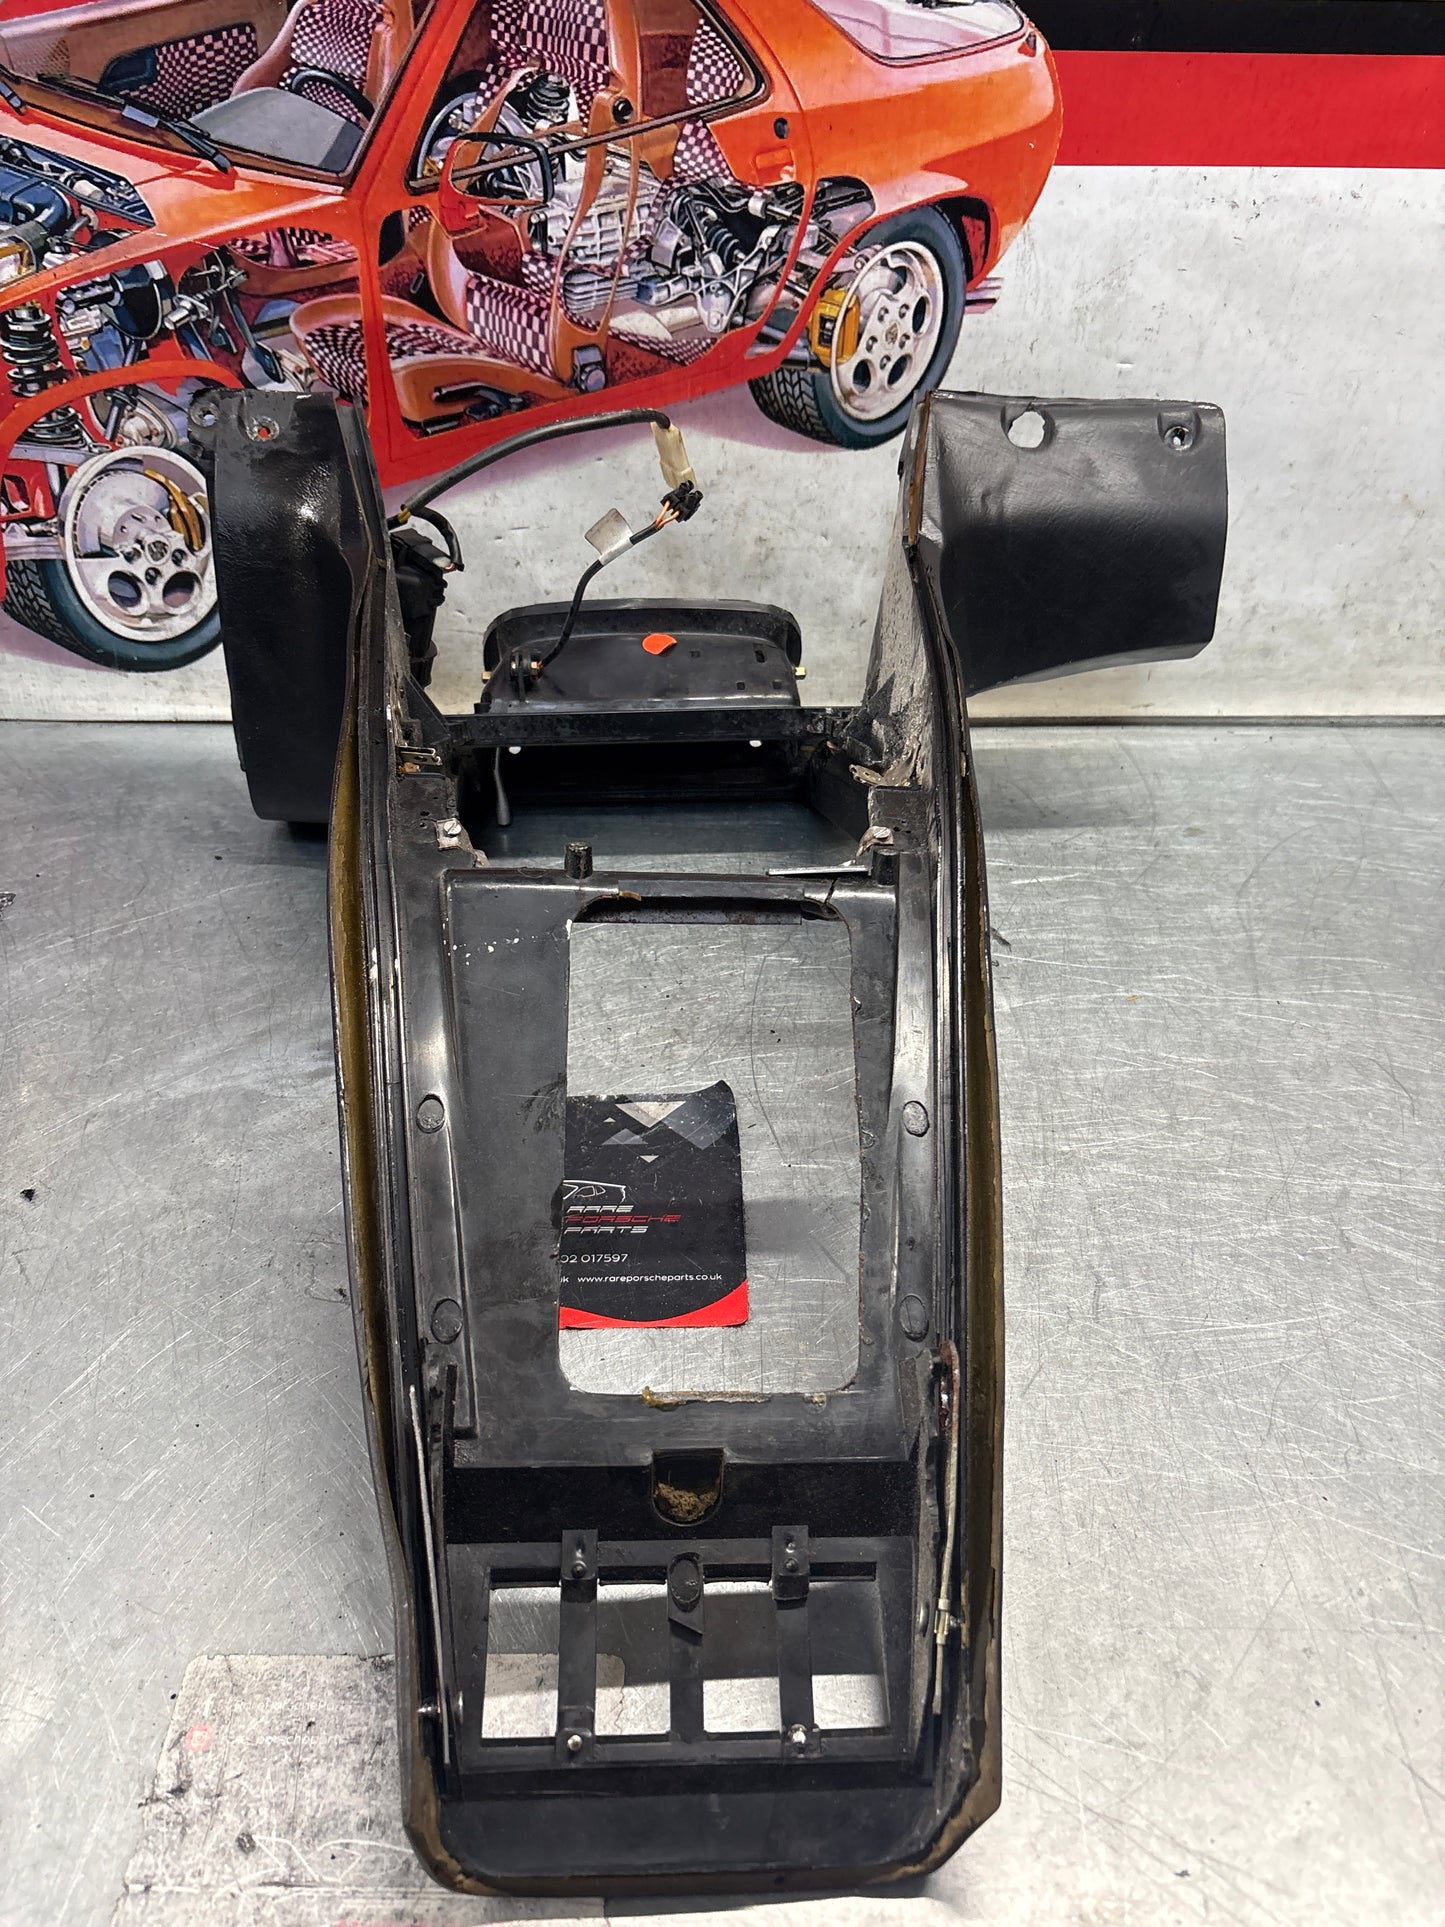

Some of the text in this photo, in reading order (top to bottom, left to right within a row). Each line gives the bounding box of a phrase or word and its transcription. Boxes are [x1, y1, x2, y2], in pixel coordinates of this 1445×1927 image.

[566, 1205, 634, 1213] RARE
[565, 1214, 682, 1223] PORSCHE
[563, 1225, 649, 1234] PARTS
[580, 1253, 629, 1263] 017597
[577, 1273, 723, 1284] www.rareporscheparts.co.uk
